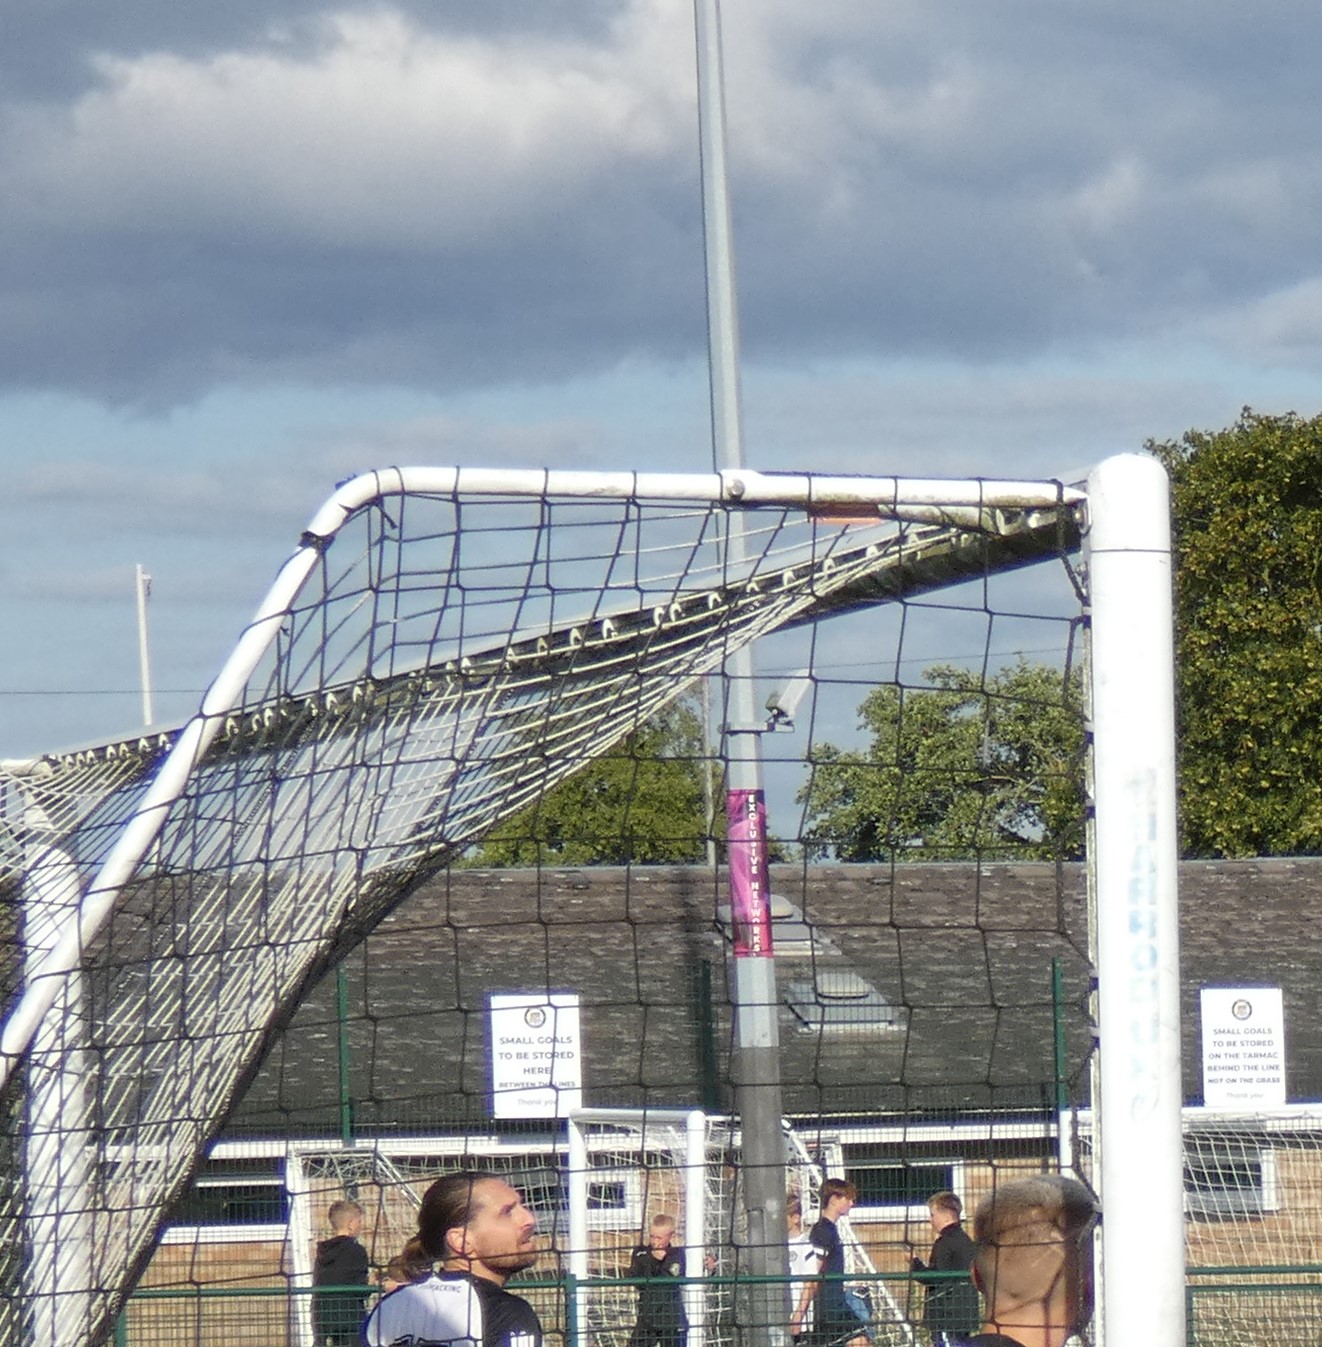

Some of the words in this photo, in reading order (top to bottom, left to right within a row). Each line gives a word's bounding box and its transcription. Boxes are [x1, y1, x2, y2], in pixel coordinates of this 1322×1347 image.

[1243, 1027, 1272, 1035] GOALS
[499, 1036, 535, 1045] SMALL
[537, 1036, 573, 1045] GOALS
[498, 1052, 513, 1060] TO
[516, 1051, 529, 1060] BE
[532, 1051, 575, 1060] STORED
[523, 1067, 551, 1075] HERE
[498, 1081, 536, 1089] BETWEEN
